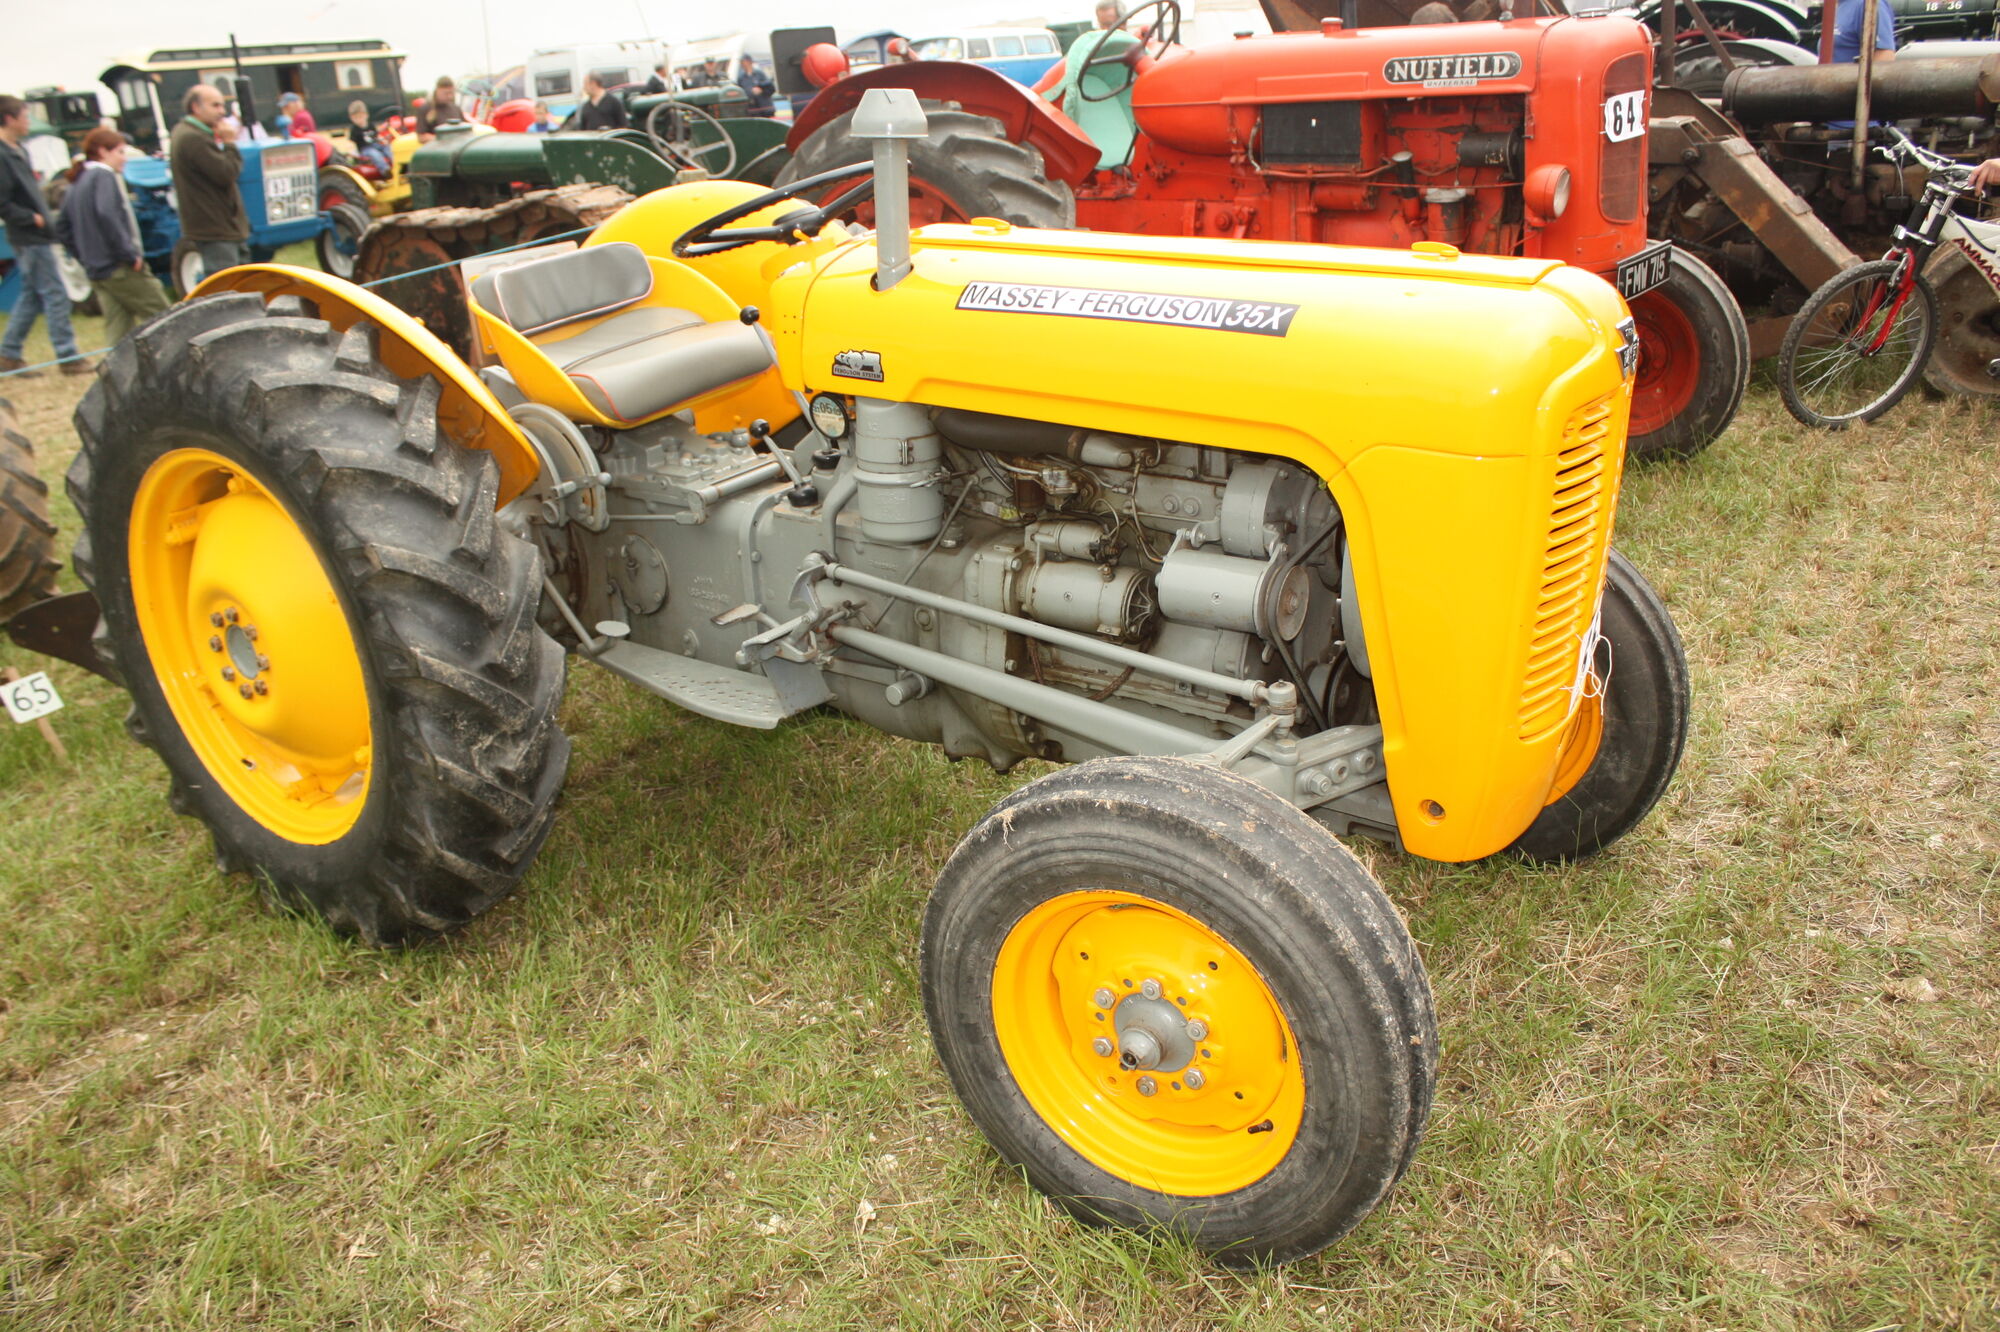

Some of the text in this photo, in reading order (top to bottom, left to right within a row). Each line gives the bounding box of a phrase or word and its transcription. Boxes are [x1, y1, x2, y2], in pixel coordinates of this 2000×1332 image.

[1925, 1, 1963, 12] 18 36
[1392, 55, 1510, 81] NUFFIELD
[1613, 96, 1635, 136] 64
[1625, 252, 1666, 297] FMW 715
[962, 284, 1293, 331] MASSEY-FERGUSON 35X
[862, 371, 881, 379] SYSTEM
[819, 402, 832, 414] 05
[13, 676, 51, 711] 65
